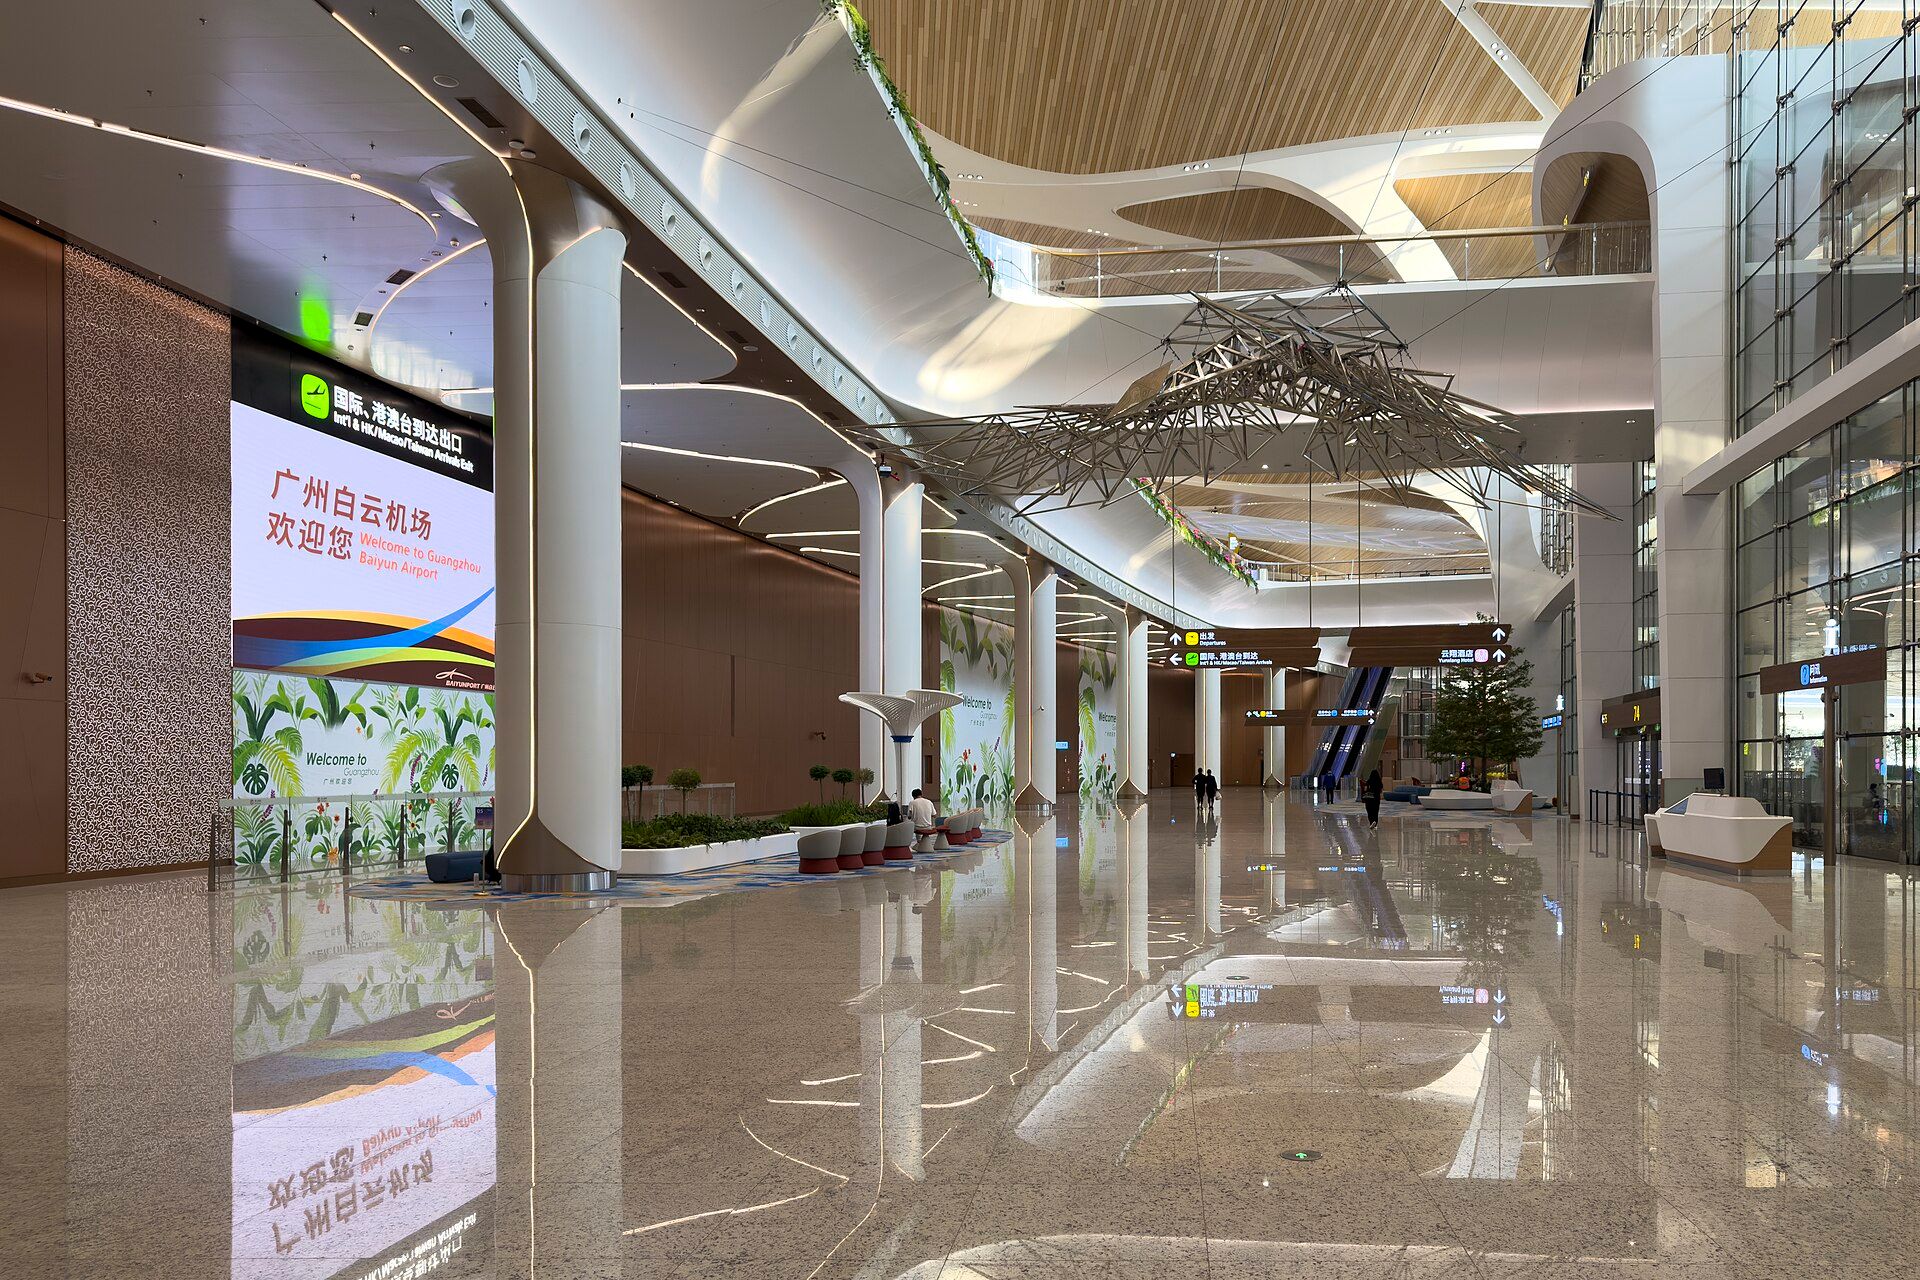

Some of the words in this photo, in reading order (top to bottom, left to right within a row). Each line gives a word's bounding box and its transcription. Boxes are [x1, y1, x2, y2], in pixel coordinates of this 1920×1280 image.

[333, 385, 462, 455] 国际、港澳台到达出口
[352, 418, 360, 431] &
[361, 421, 434, 459] HK/Macao/Taiwan
[434, 447, 460, 469] Arrivals
[460, 458, 475, 473] Exit
[271, 468, 432, 541] 广州白云机场
[266, 511, 354, 560] 欢迎您
[359, 531, 411, 556] Welcome
[413, 544, 424, 560] to
[427, 549, 481, 575] Guangzhou
[359, 551, 398, 571] Baiyun
[400, 561, 438, 580] Airport
[1200, 632, 1215, 640] 出发
[963, 695, 986, 709] Welcome
[306, 752, 355, 766] Welcome
[357, 753, 367, 766] to
[343, 767, 380, 778] Guangzhou
